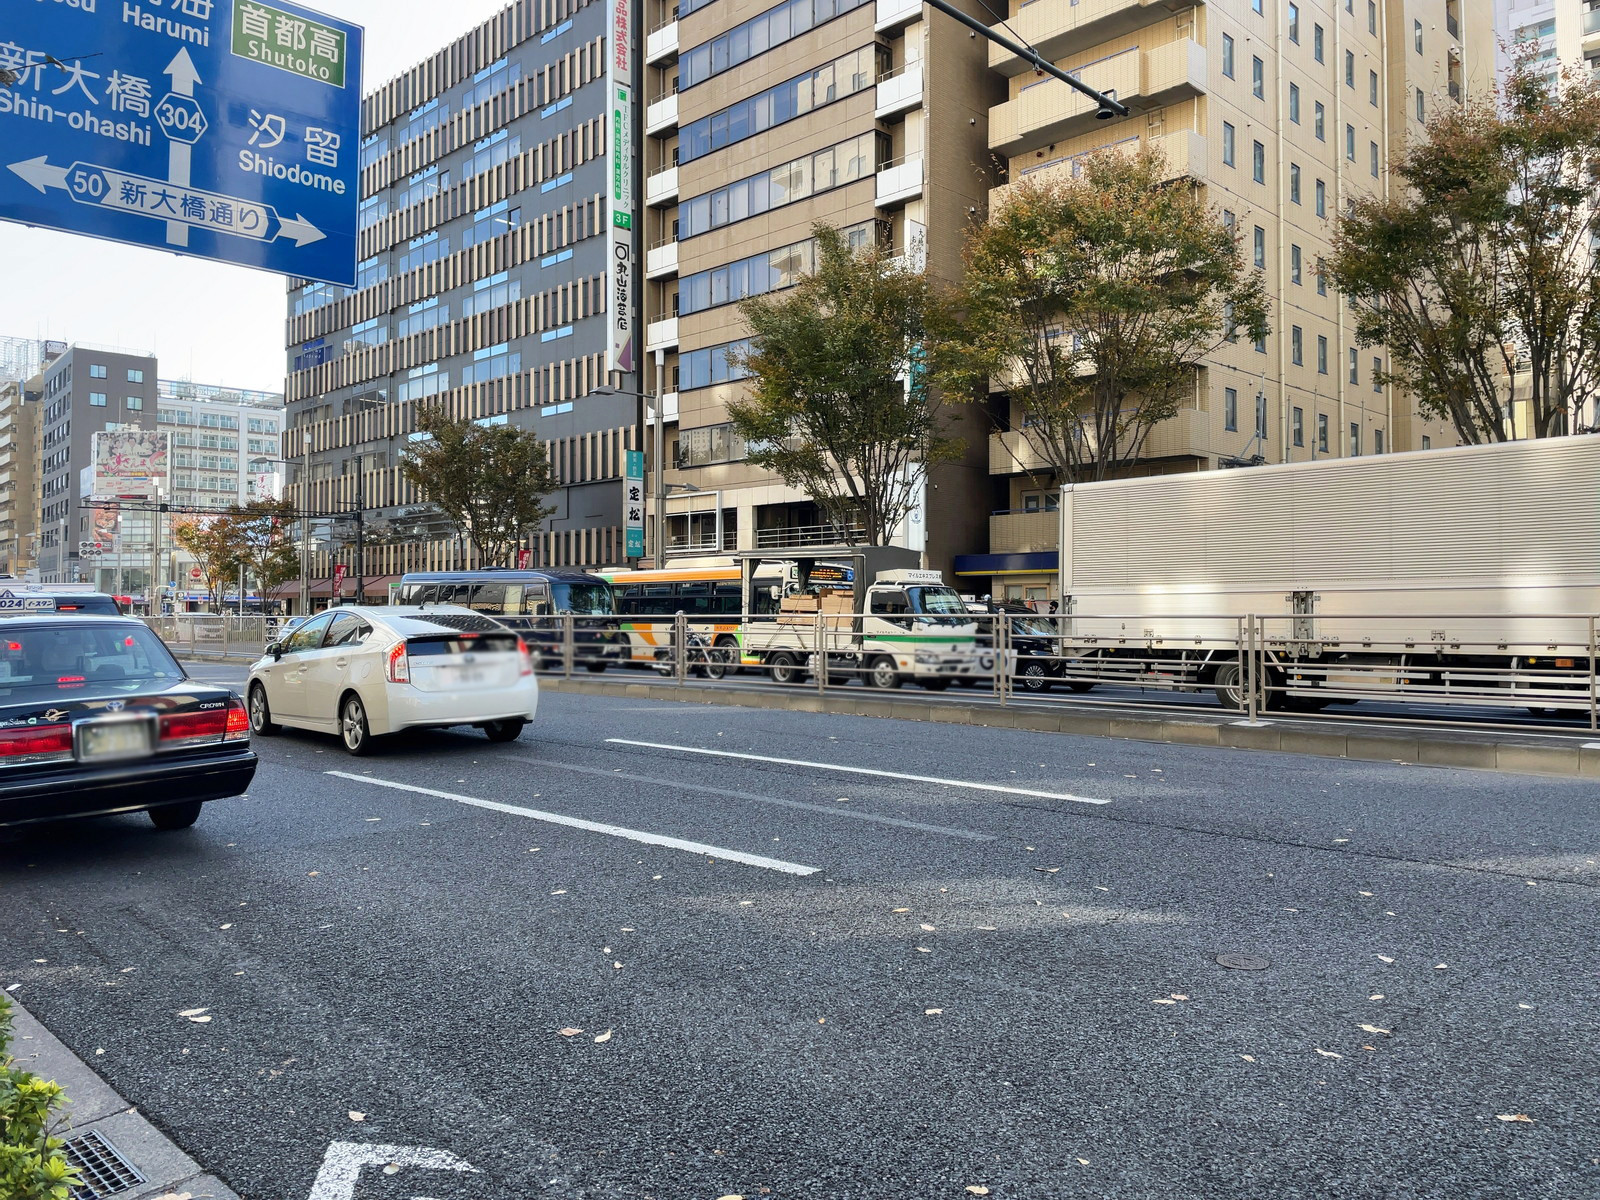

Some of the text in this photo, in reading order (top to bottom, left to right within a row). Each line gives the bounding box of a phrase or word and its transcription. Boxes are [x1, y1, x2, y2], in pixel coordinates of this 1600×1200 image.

[123, 2, 209, 47] Harumi
[239, 4, 341, 63] 首都高
[616, 0, 628, 71] 品株式会社
[0, 41, 152, 118] 新大橋
[248, 40, 330, 80] Shutoko
[0, 88, 151, 147] Shin-ohashi
[160, 103, 202, 134] 304
[247, 109, 341, 168] 汐留
[73, 170, 103, 197] 50
[238, 149, 346, 195] Shiodome
[119, 180, 260, 231] 新大橋通り
[615, 213, 629, 225] 3F
[616, 261, 629, 331] 丸山海苔店
[628, 486, 641, 521] 定松
